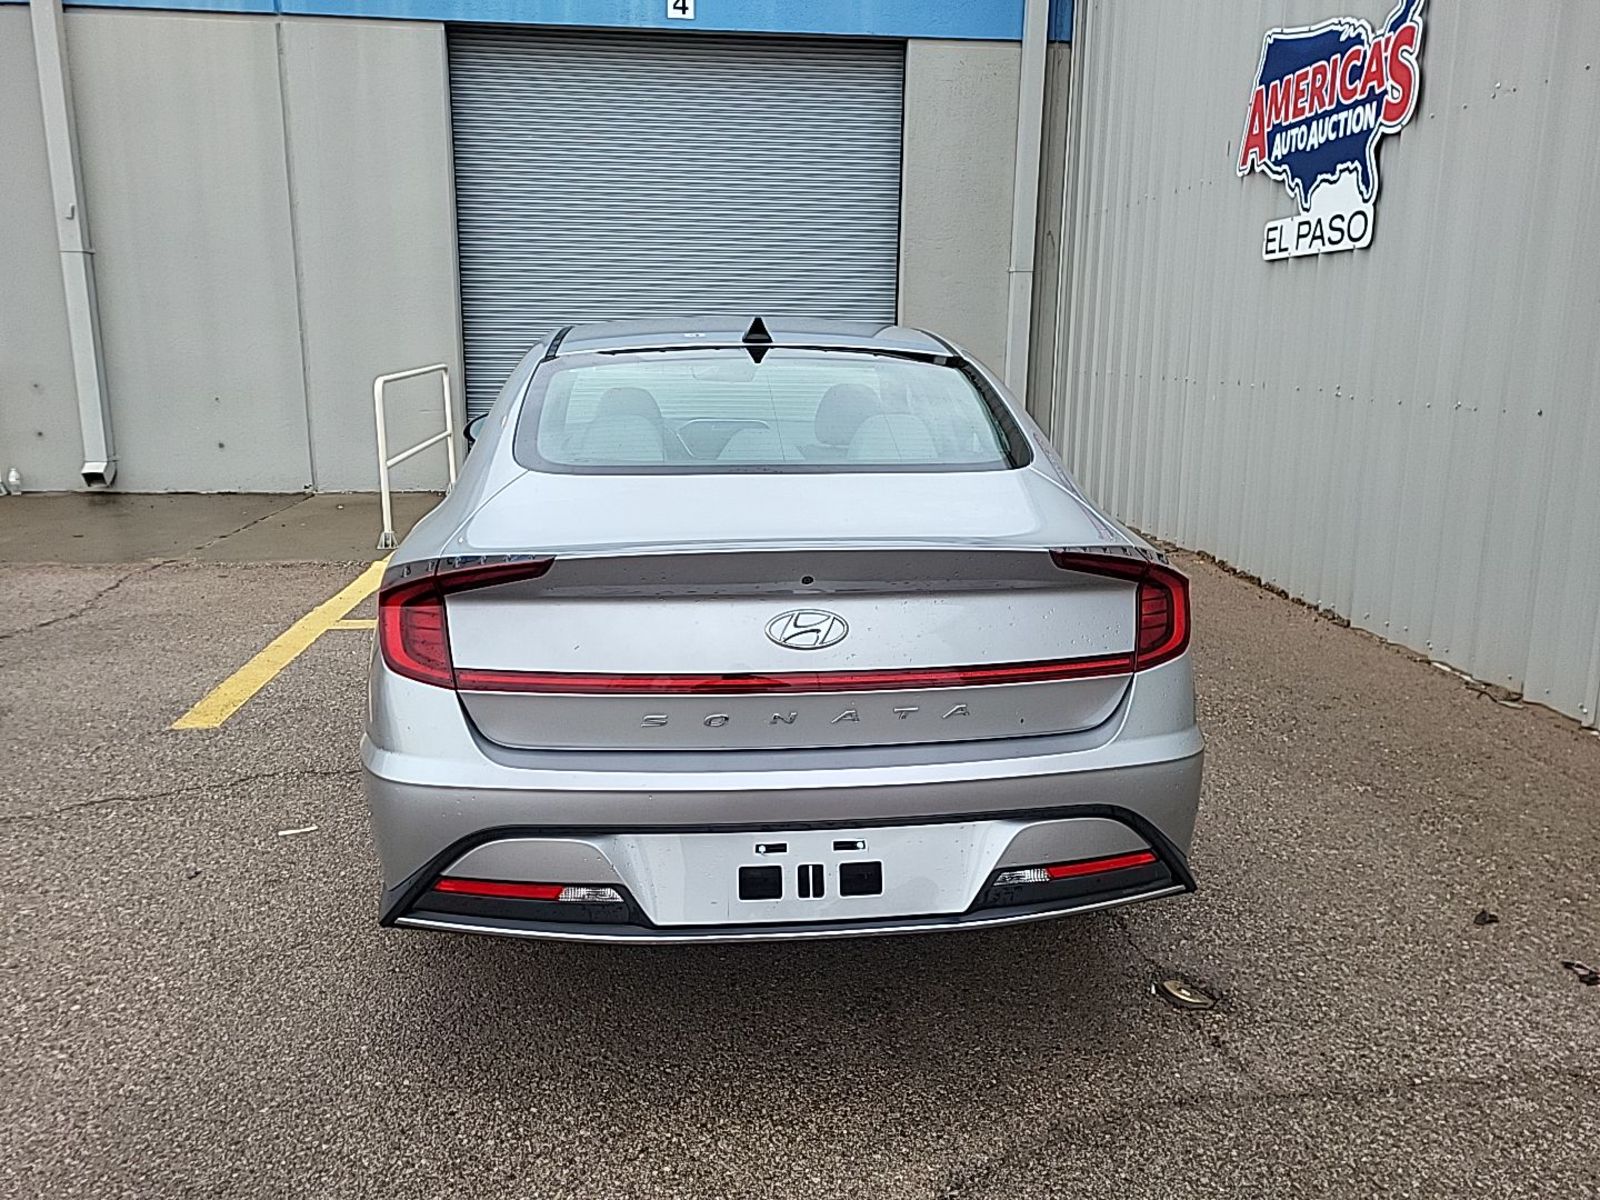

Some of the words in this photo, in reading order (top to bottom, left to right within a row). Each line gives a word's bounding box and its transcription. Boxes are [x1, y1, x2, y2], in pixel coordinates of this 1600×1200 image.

[672, 0, 689, 15] 4
[1239, 24, 1417, 169] AMERICA'S
[1265, 225, 1290, 255] EL
[1296, 210, 1369, 250] PASO
[640, 703, 971, 728] SONATA
